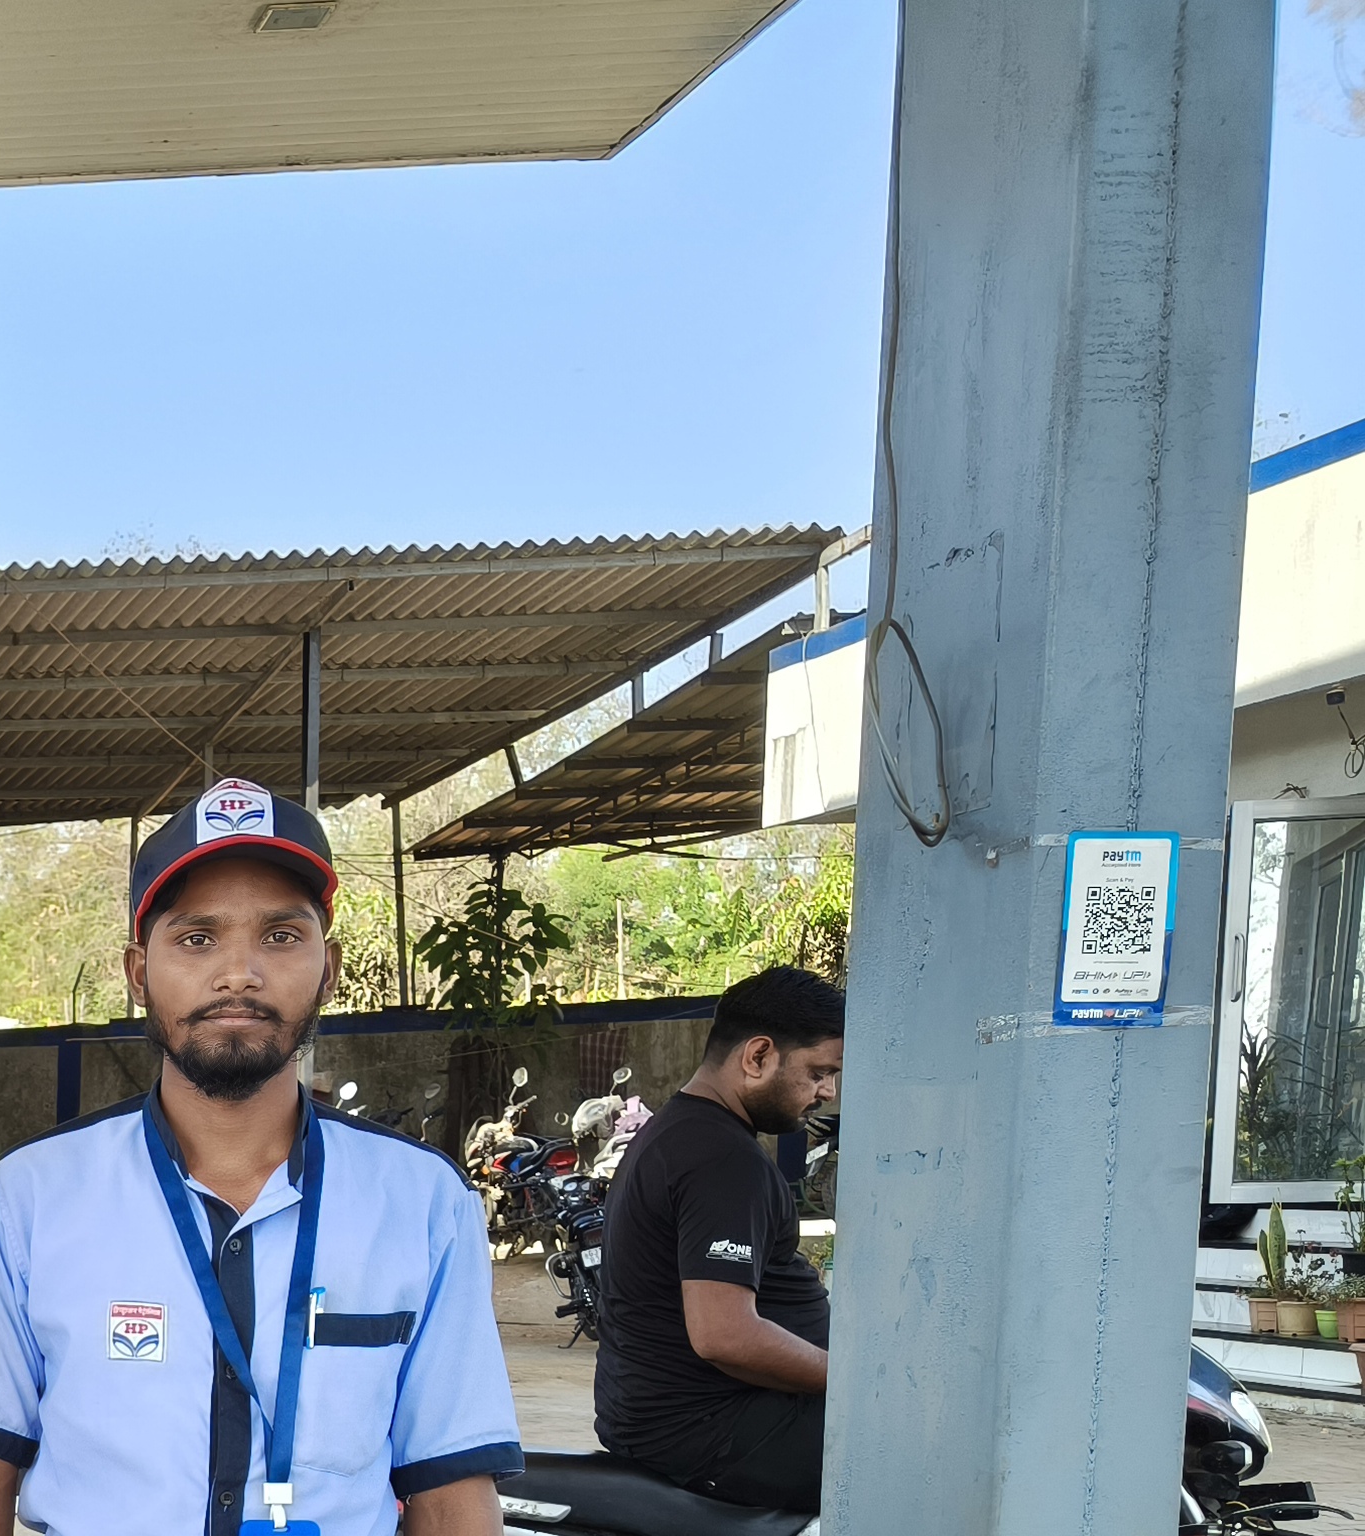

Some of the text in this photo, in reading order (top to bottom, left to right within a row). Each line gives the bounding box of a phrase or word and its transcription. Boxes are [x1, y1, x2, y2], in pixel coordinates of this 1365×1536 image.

[220, 800, 252, 810] HP
[1074, 971, 1146, 979] BHIM UPI
[125, 1323, 148, 1334] HP
